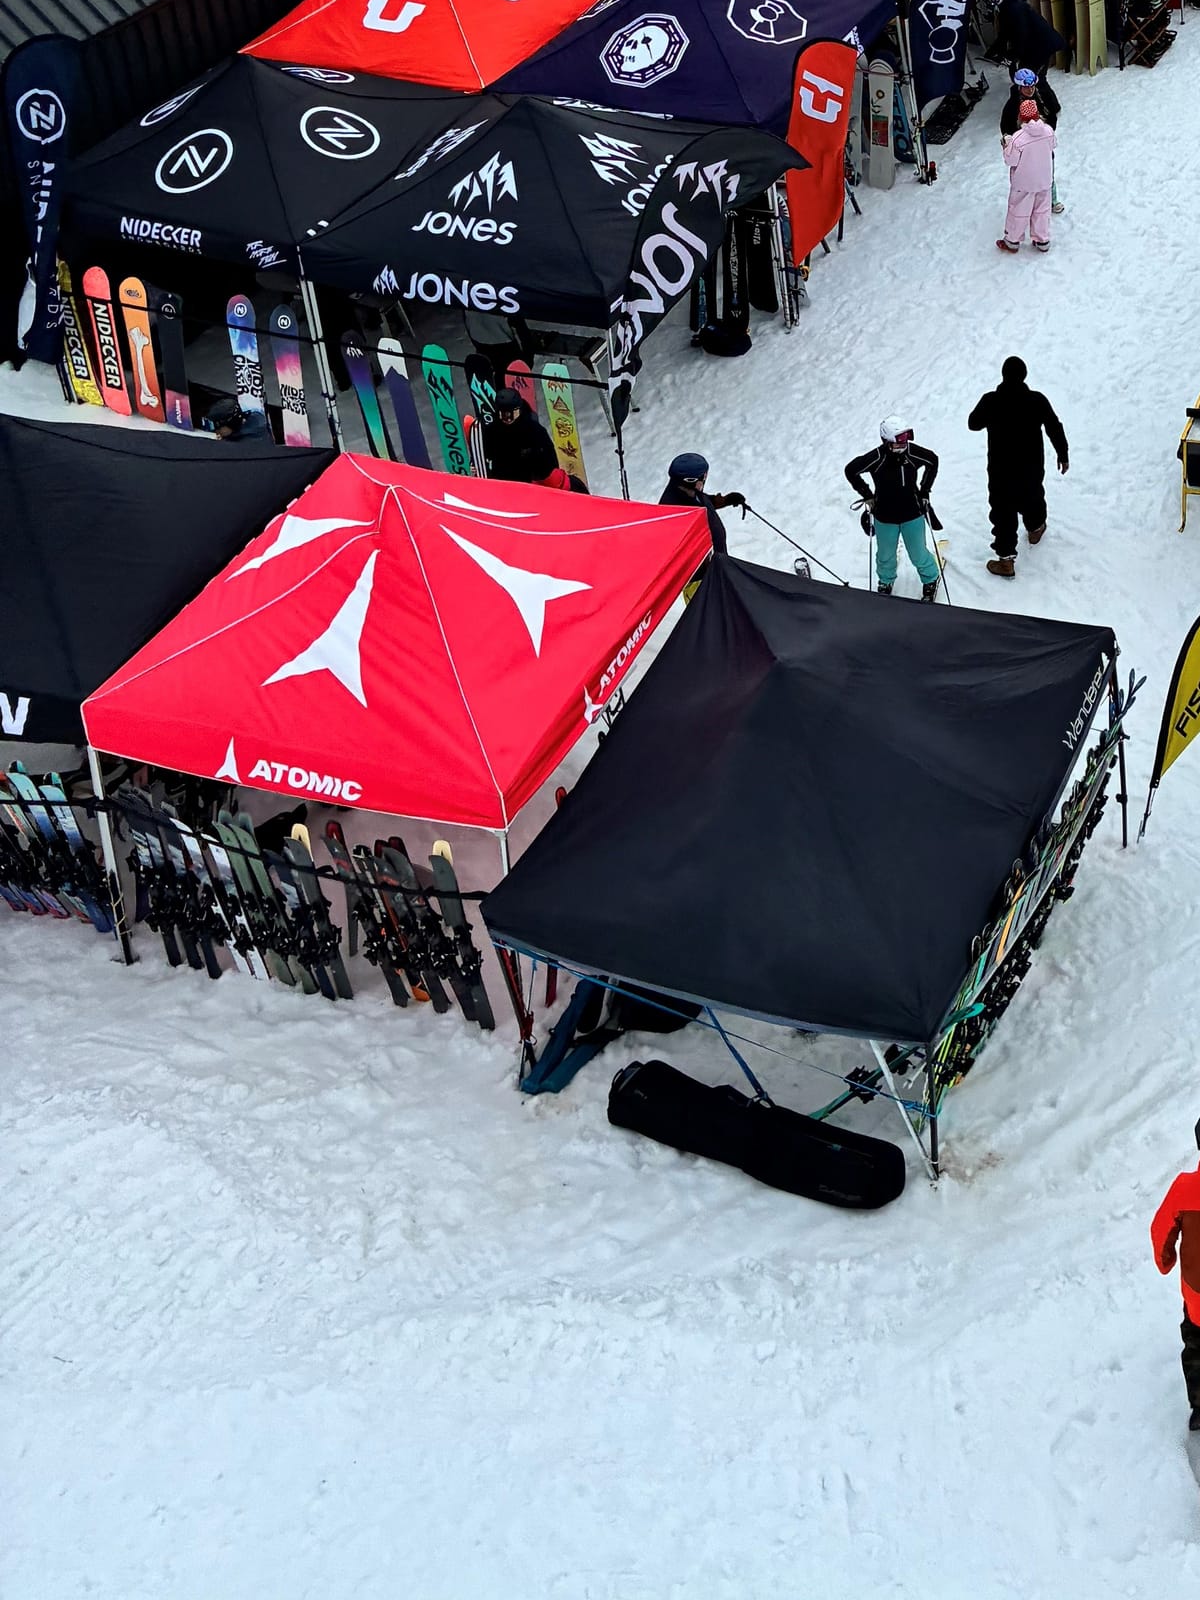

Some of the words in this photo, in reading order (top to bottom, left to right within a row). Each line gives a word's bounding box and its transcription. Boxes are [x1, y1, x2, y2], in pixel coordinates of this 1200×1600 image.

[120, 216, 202, 248] NIDECKER
[92, 302, 121, 388] NIDECKER
[598, 609, 652, 698] ATOMIC
[1062, 666, 1105, 750] Wanderer
[248, 758, 363, 802] ATOMIC
